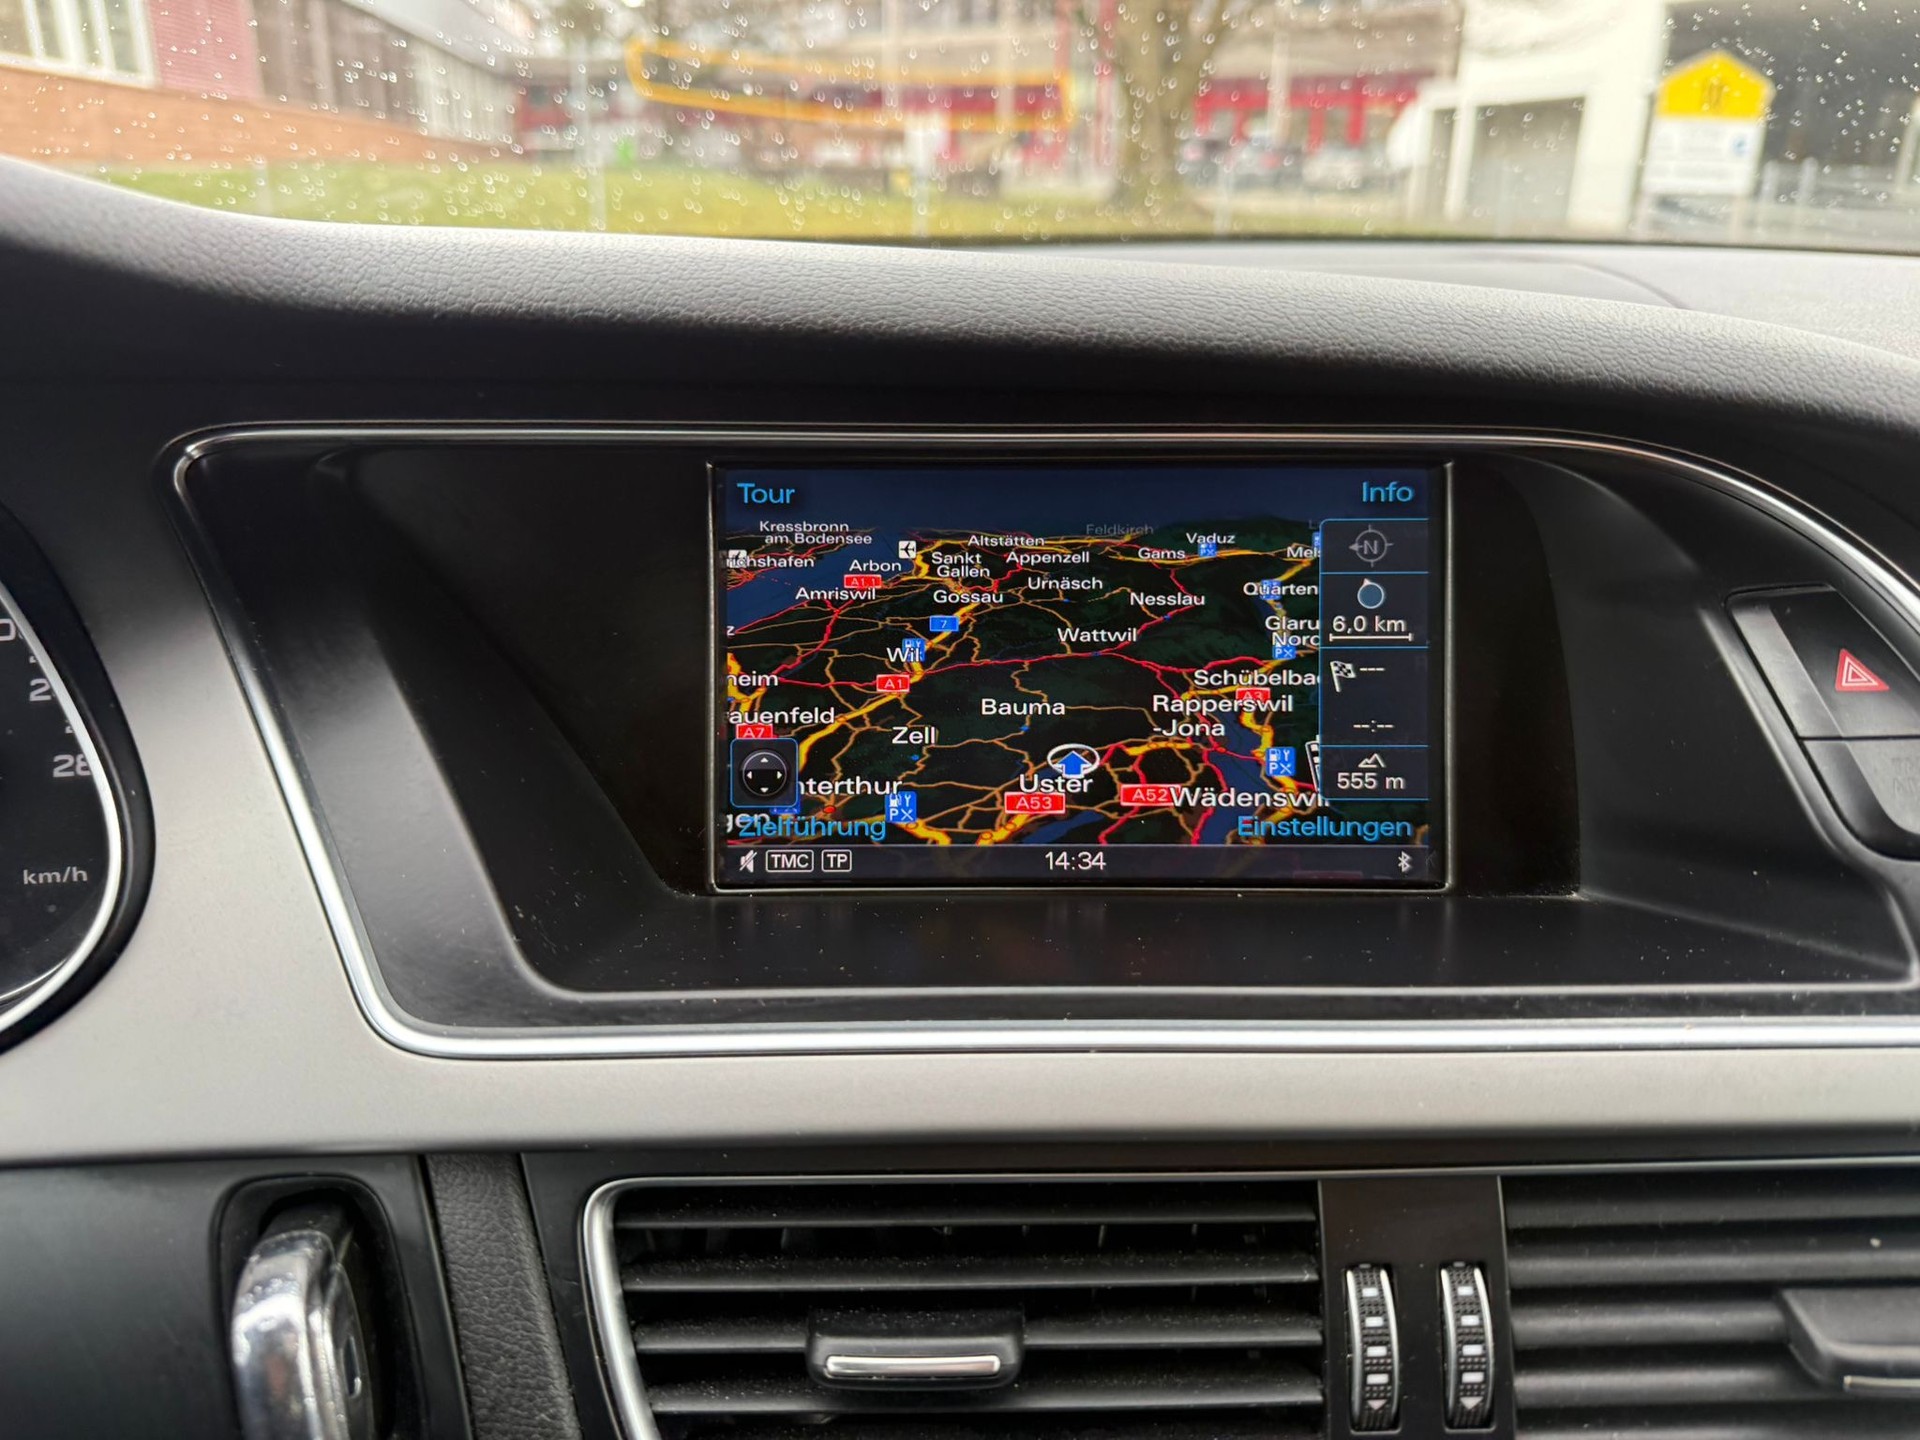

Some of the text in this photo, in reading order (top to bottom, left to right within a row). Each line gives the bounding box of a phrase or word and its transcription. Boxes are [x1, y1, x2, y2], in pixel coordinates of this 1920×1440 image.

[737, 483, 796, 504] Tour
[1362, 482, 1414, 503] Info
[759, 520, 849, 533] Kressbronn
[1085, 523, 1154, 536] Feldkirch
[764, 532, 873, 545] am Bodensee
[967, 535, 1045, 547] Altstätten
[1186, 532, 1236, 545] Vaduz
[931, 551, 982, 564] Sankt
[1005, 551, 1091, 566] Appenzell
[1137, 547, 1186, 560] Gams
[849, 559, 902, 572] Arbon
[936, 565, 991, 578] Gallen
[1028, 576, 1103, 590] Urnäsch
[1243, 582, 1319, 597] Quarten
[795, 587, 876, 600] Amriswil
[933, 589, 1004, 604] Gossau
[1130, 592, 1206, 606] Nesslau
[1332, 615, 1406, 634] 6,0 km
[1057, 627, 1138, 643] Wattwil
[887, 647, 919, 662] Wil
[884, 678, 903, 689] A1
[1193, 669, 1320, 686] Schübelba
[981, 698, 1066, 716] Bauma
[1153, 694, 1293, 716] Rapperswil
[727, 707, 835, 724] auenfeld
[743, 728, 765, 738] A7
[891, 727, 936, 744] Zell
[1019, 774, 1094, 793] Uster
[1337, 772, 1406, 789] 555 m
[1132, 788, 1169, 802] A52
[1171, 787, 1330, 807] Wädenswi
[1016, 797, 1053, 810] A53
[738, 816, 887, 841] Zielführung
[1238, 816, 1412, 841] Einstellungen
[771, 854, 809, 869] TMC
[826, 854, 848, 868] TP
[1045, 851, 1107, 870] 14:34
[23, 867, 88, 884] km/h
